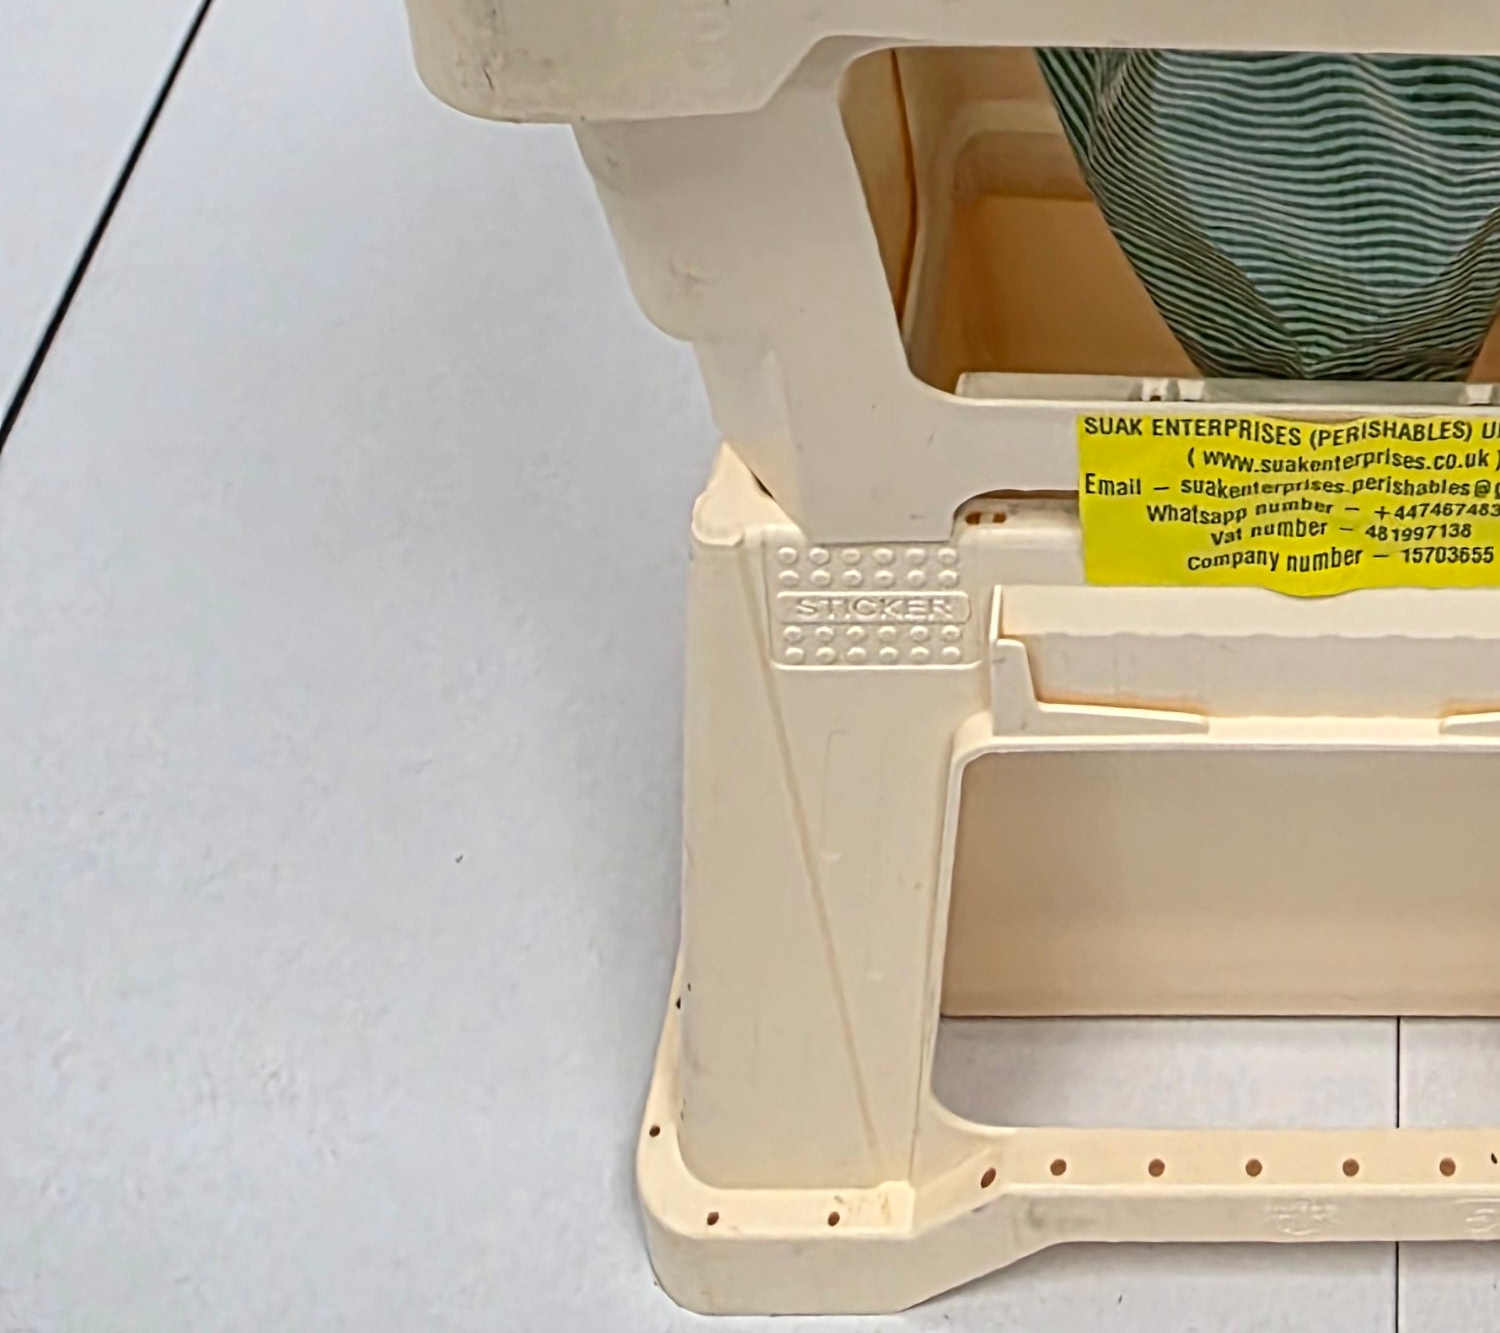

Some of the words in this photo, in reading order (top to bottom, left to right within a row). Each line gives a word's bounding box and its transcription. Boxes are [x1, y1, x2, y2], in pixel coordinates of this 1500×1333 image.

[1084, 417, 1143, 436] SUAK
[1152, 418, 1301, 446] ENTERPRISES
[1309, 420, 1473, 450] (PERISHABLES)
[1203, 448, 1490, 473] www.suakenterprises.co.uk
[1085, 473, 1142, 495] Email
[1146, 504, 1247, 527] Whatsapp
[1255, 497, 1334, 516] number
[1211, 527, 1242, 546] Vat
[1250, 517, 1328, 539] number
[1187, 548, 1280, 573] Company
[1287, 546, 1363, 573] number
[1402, 546, 1494, 565] 15703655
[795, 598, 953, 621] STICKER
